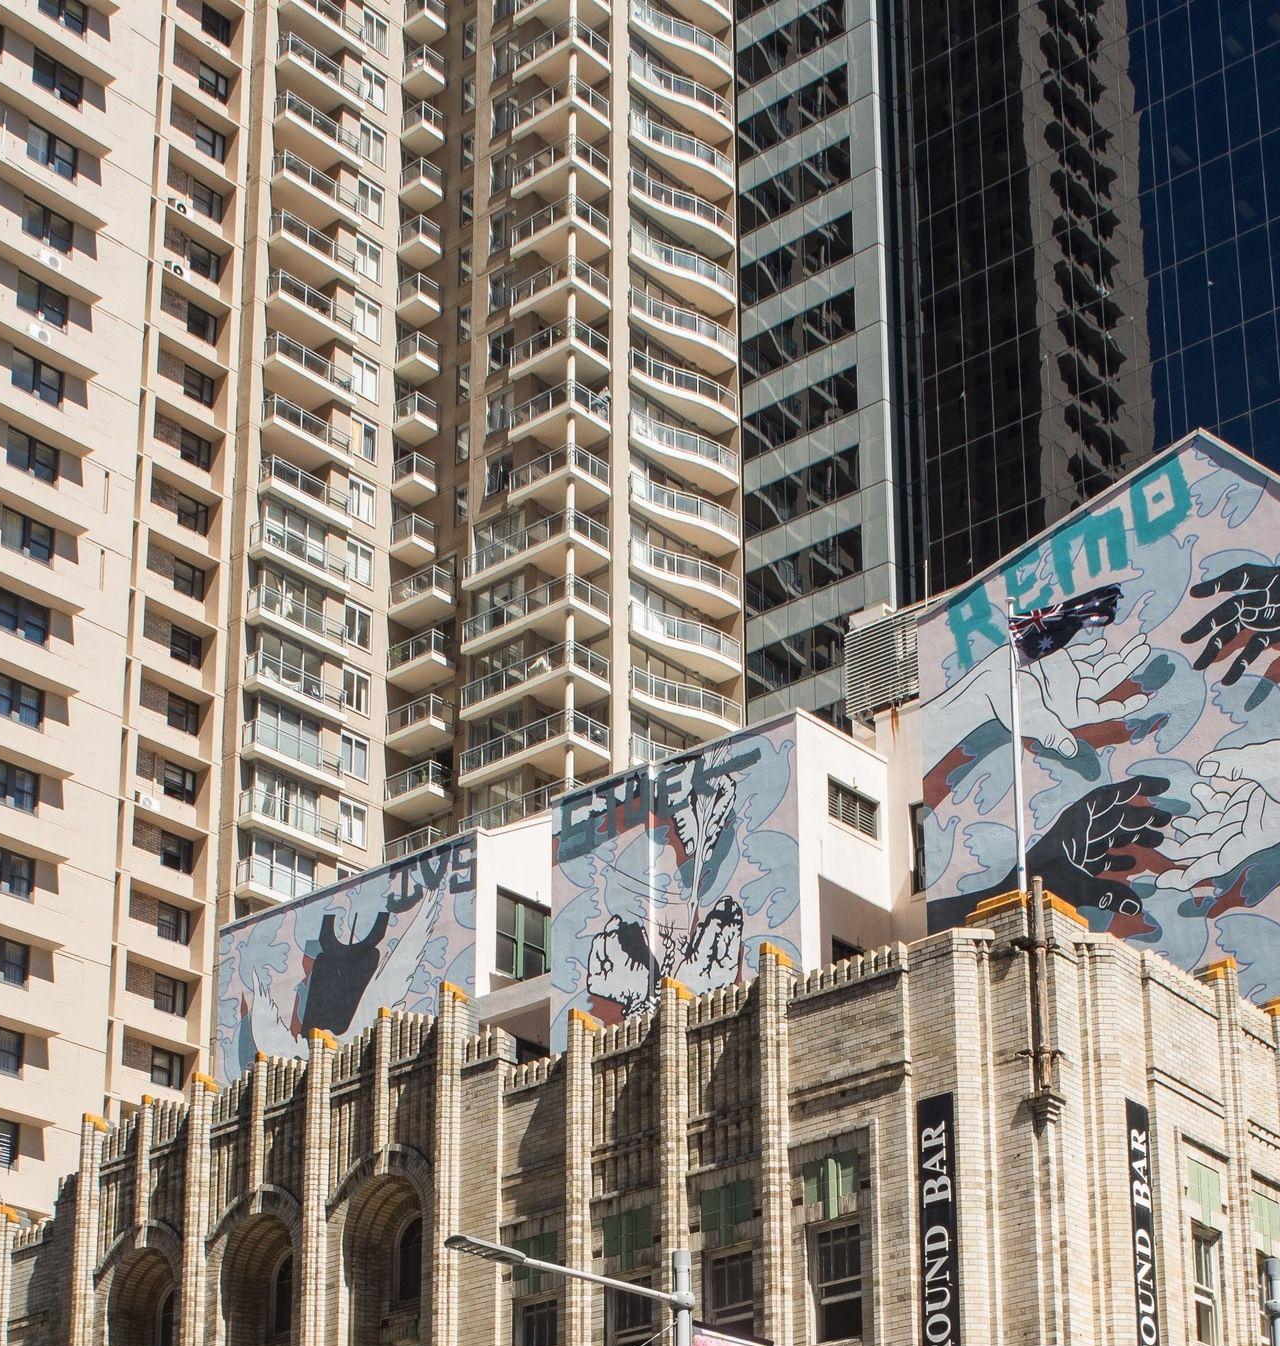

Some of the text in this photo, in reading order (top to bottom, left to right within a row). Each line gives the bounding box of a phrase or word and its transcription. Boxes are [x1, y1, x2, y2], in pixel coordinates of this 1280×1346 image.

[946, 454, 1193, 670] REMO
[921, 1120, 952, 1209] BAR
[1130, 1127, 1154, 1209] BAR
